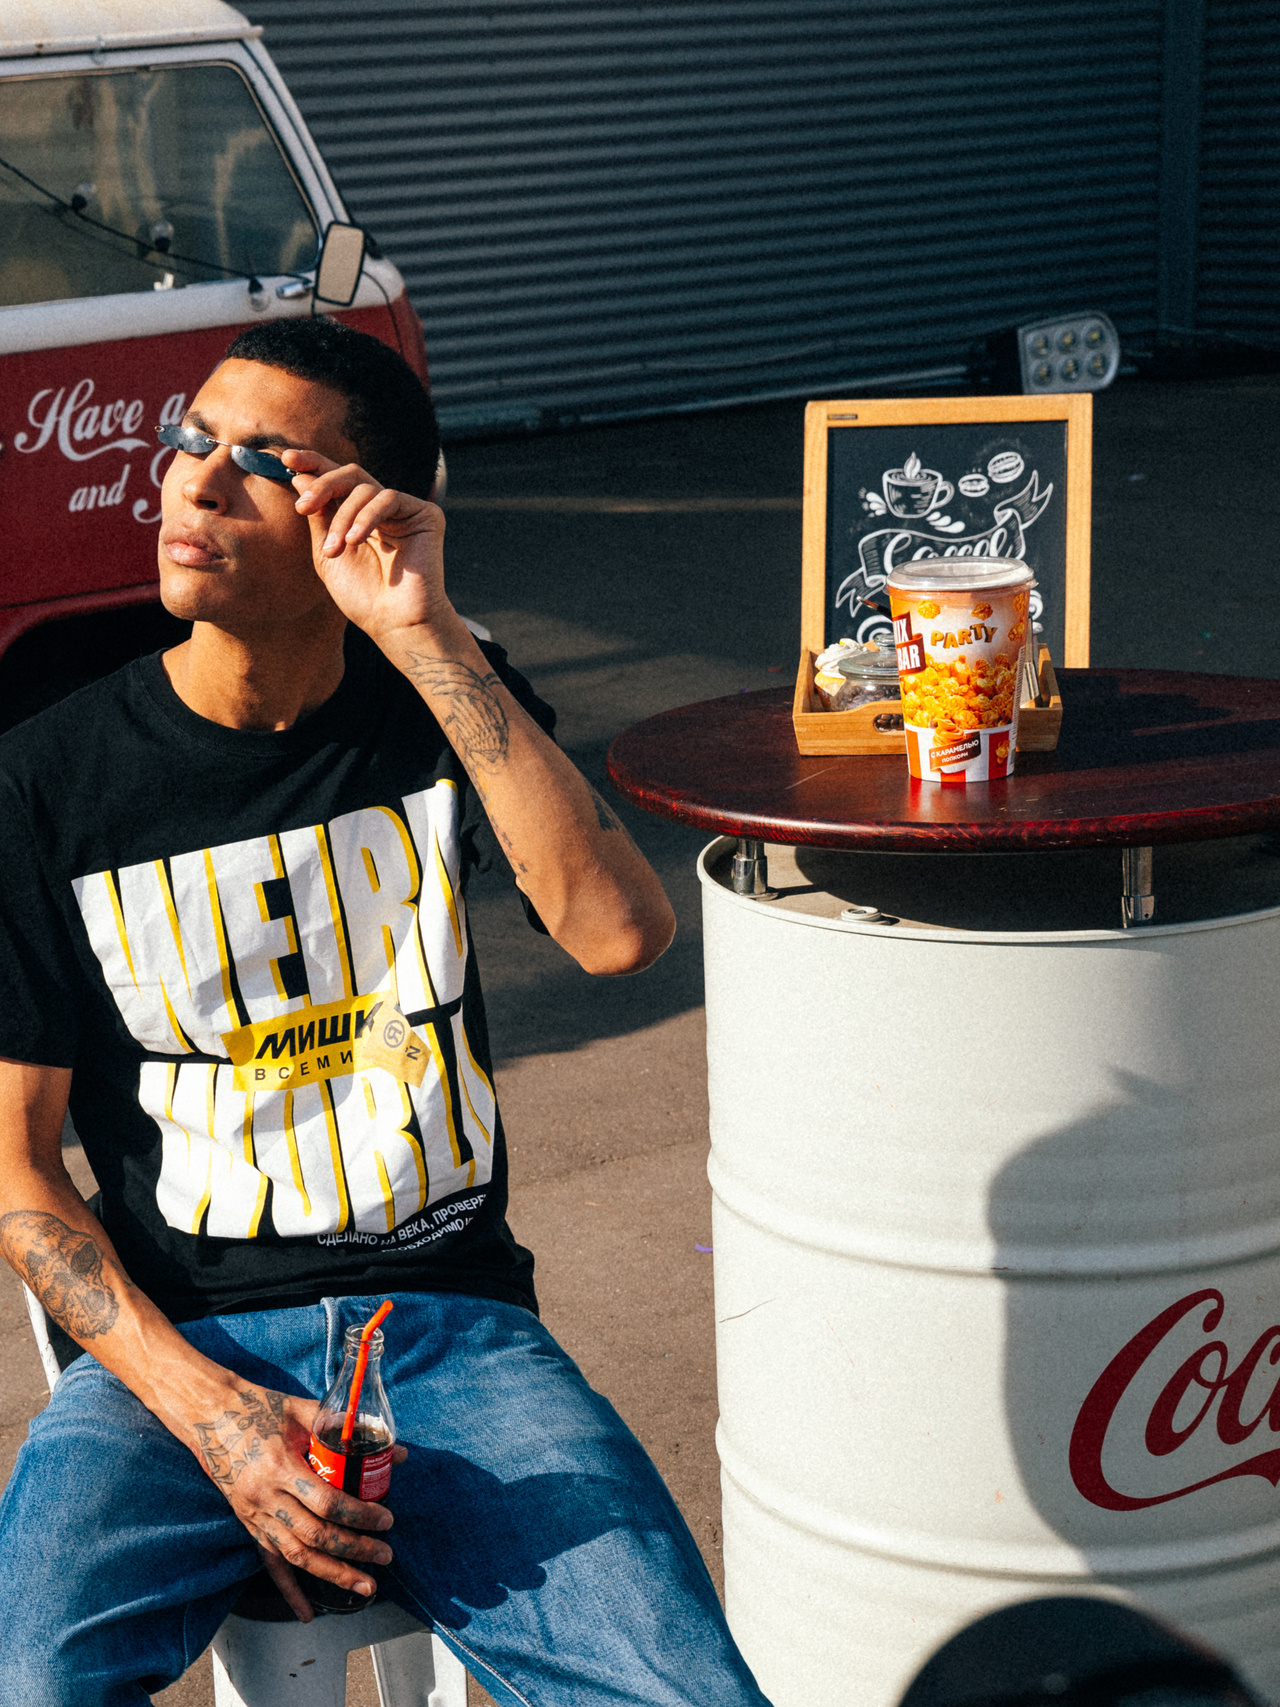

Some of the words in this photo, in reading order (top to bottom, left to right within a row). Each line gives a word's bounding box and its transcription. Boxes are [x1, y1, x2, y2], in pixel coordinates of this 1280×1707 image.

[14, 378, 151, 461] Have
[69, 464, 130, 512] and
[930, 623, 998, 649] PARTY
[936, 739, 979, 757] КАРАМЕЛЬЮ
[941, 751, 969, 763] ПОПКОРН
[71, 779, 468, 1059] WEIRD
[255, 1001, 385, 1059] МИШК
[255, 1050, 354, 1081] ВСЕМИ
[317, 1231, 378, 1246] СДЕЛАНО
[398, 1218, 435, 1241] ВЕКА,
